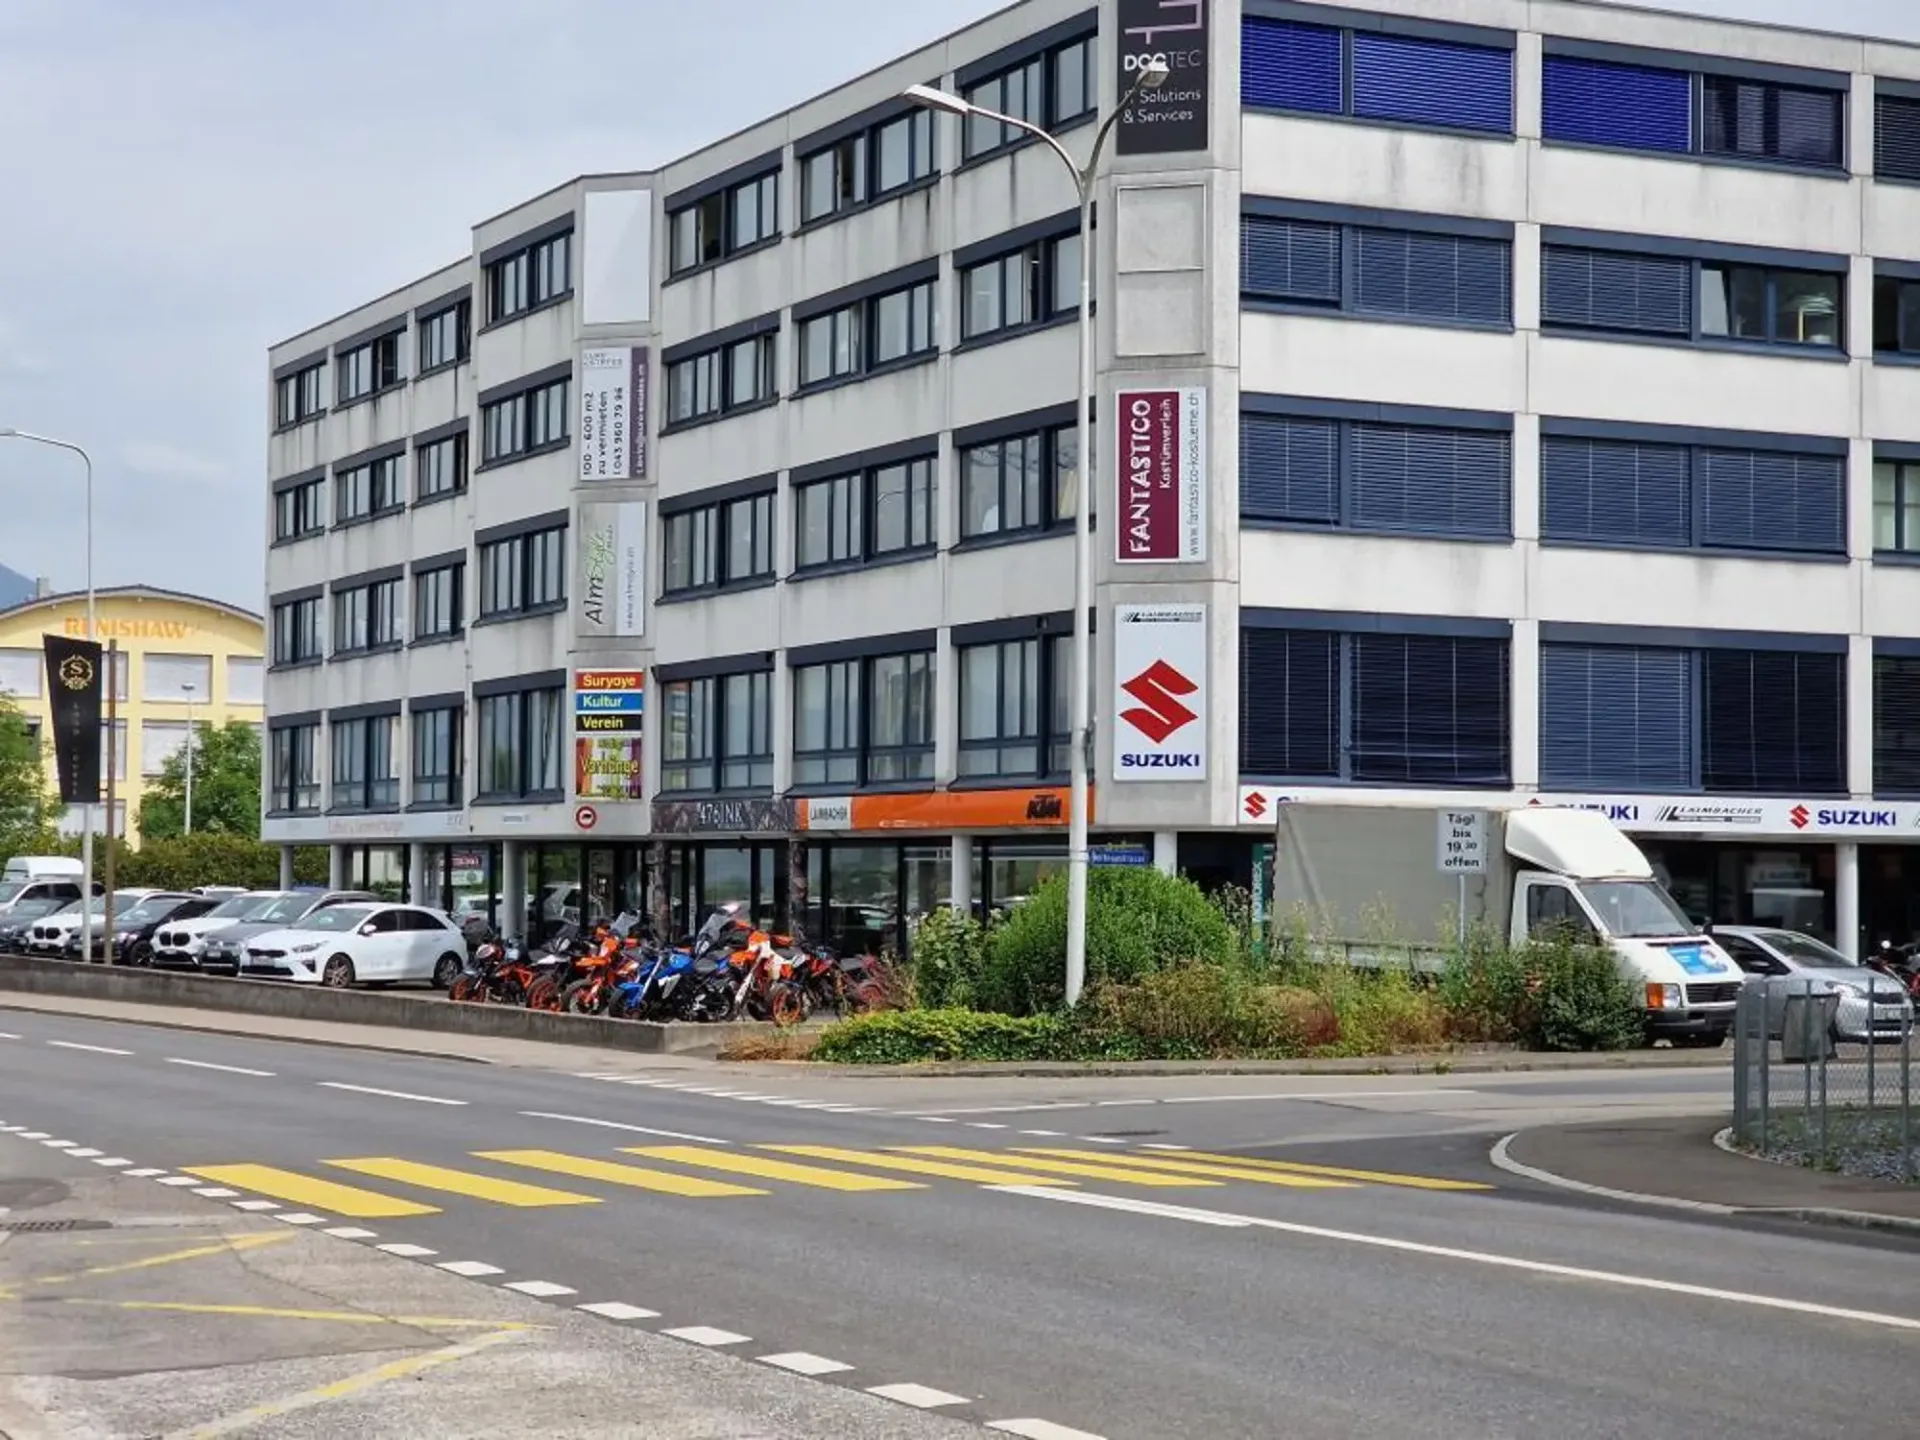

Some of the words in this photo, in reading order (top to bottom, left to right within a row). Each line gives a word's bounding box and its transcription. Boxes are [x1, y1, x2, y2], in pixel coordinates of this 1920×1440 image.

[1139, 87, 1202, 105] Solutions
[1122, 108, 1135, 124] &
[1137, 108, 1194, 124] Services
[583, 415, 593, 441] 600
[598, 391, 608, 457] vermieten
[1158, 398, 1172, 489] Kostümverleih
[583, 453, 593, 475] 100
[1129, 399, 1152, 553] FANTASTICO
[582, 674, 637, 690] Suryoye
[582, 695, 624, 708] Kultur
[582, 715, 625, 729] Verein
[1121, 753, 1200, 768] SUZUKI
[1026, 794, 1063, 820] KTM
[1817, 809, 1898, 828] SUZUKI
[1444, 856, 1480, 867] offen
